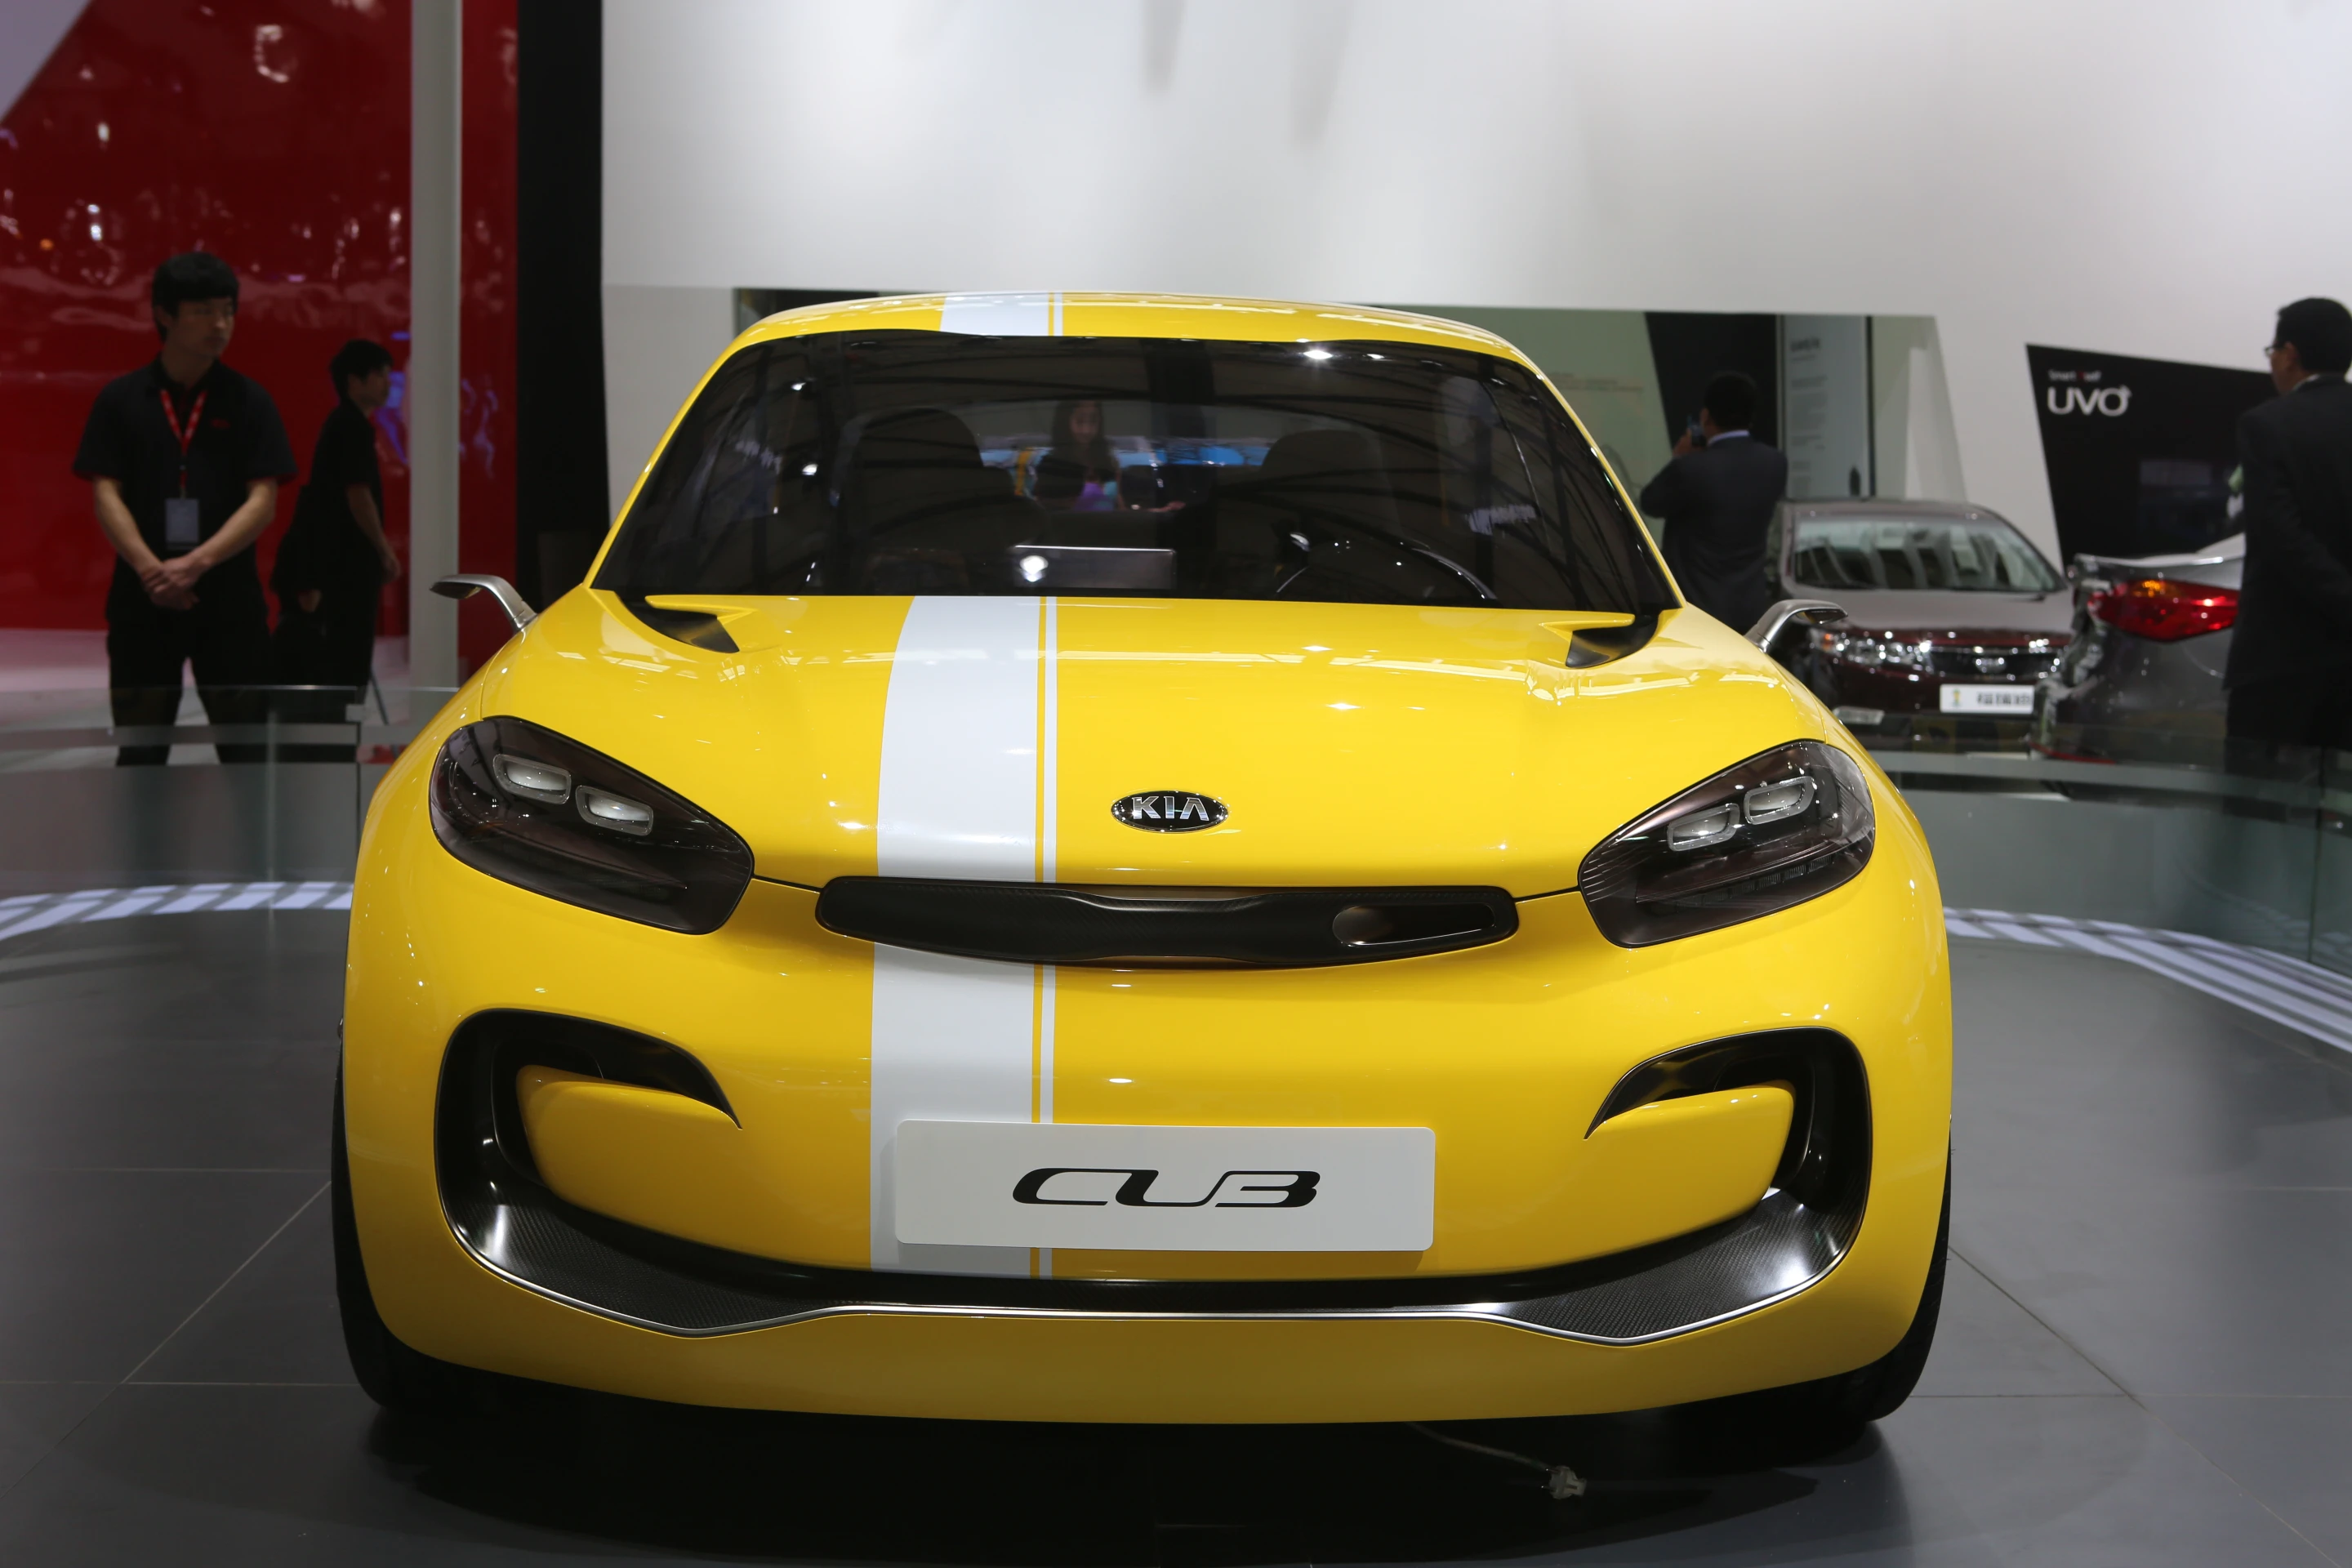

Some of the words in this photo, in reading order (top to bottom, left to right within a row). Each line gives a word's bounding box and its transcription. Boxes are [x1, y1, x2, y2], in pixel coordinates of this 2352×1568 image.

[2047, 385, 2130, 416] UVO
[1132, 795, 1209, 822] KIA
[1013, 1167, 1321, 1208] CUB
